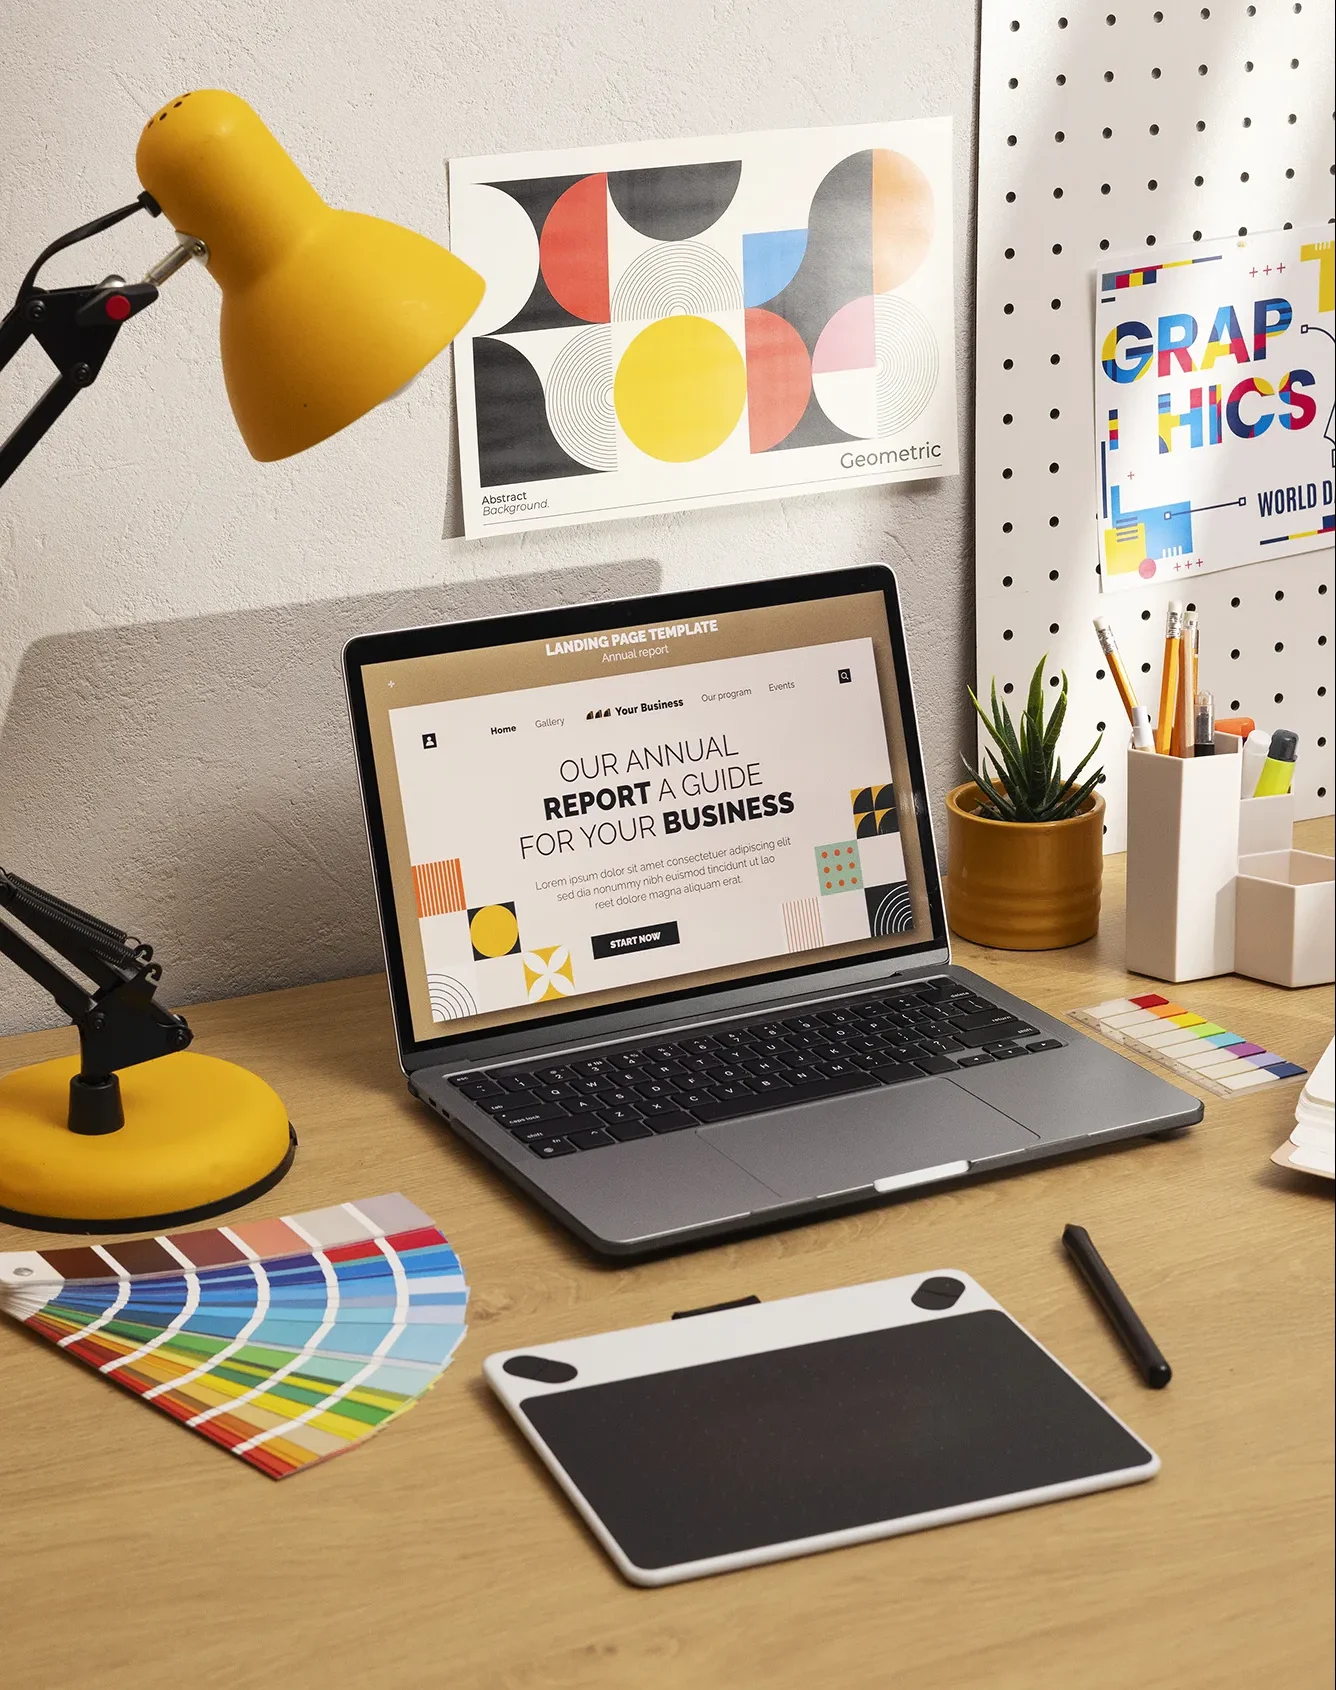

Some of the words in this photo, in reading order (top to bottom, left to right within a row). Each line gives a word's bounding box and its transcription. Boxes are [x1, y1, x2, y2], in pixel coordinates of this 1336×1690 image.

[1101, 298, 1293, 384] GRAP
[1158, 368, 1317, 455] HICS
[840, 442, 942, 469] Geometric
[482, 492, 527, 505] Abstract
[482, 498, 550, 516] Background.
[1258, 483, 1317, 518] WORLD
[1322, 480, 1335, 506] D
[545, 635, 609, 656] LANDING
[611, 630, 647, 647] PAGE
[648, 620, 719, 641] TEMPLATE
[601, 648, 638, 663] Annual
[638, 644, 670, 659] report
[701, 693, 716, 702] Our
[718, 688, 752, 702] program
[768, 681, 796, 692] Events
[614, 703, 639, 717] Your
[640, 698, 684, 713] Business
[490, 725, 517, 736] Home
[535, 717, 565, 729] Gallery
[560, 752, 620, 783] OUR
[626, 734, 740, 773] ANNUAL
[543, 781, 651, 821] REPORT
[658, 778, 677, 802] A
[682, 763, 763, 797] GUIDE
[520, 829, 575, 860] FOR
[580, 815, 657, 848] YOUR
[662, 792, 796, 835] BUSINESS
[536, 878, 567, 891] Lorem
[569, 872, 599, 886] ipsum
[600, 867, 625, 880] dolor
[628, 864, 638, 874] sit
[640, 859, 664, 872] amet
[666, 849, 728, 868] consectetuer
[729, 840, 776, 856] adipiscing
[777, 837, 792, 848] elit
[557, 890, 575, 902] sed
[576, 888, 591, 899] dia
[594, 880, 642, 895] nonummy
[643, 874, 664, 886] nibh
[665, 866, 706, 882] euismod
[707, 859, 748, 875] tincidunt
[750, 857, 759, 866] ut
[760, 855, 776, 865] lao
[595, 899, 615, 910] reet
[616, 892, 647, 906] dolore
[649, 886, 682, 900] magna
[684, 879, 721, 894] aliquam
[722, 874, 744, 887] erat.
[610, 936, 638, 949] START
[639, 932, 662, 944] NOW
[586, 1081, 598, 1089] W
